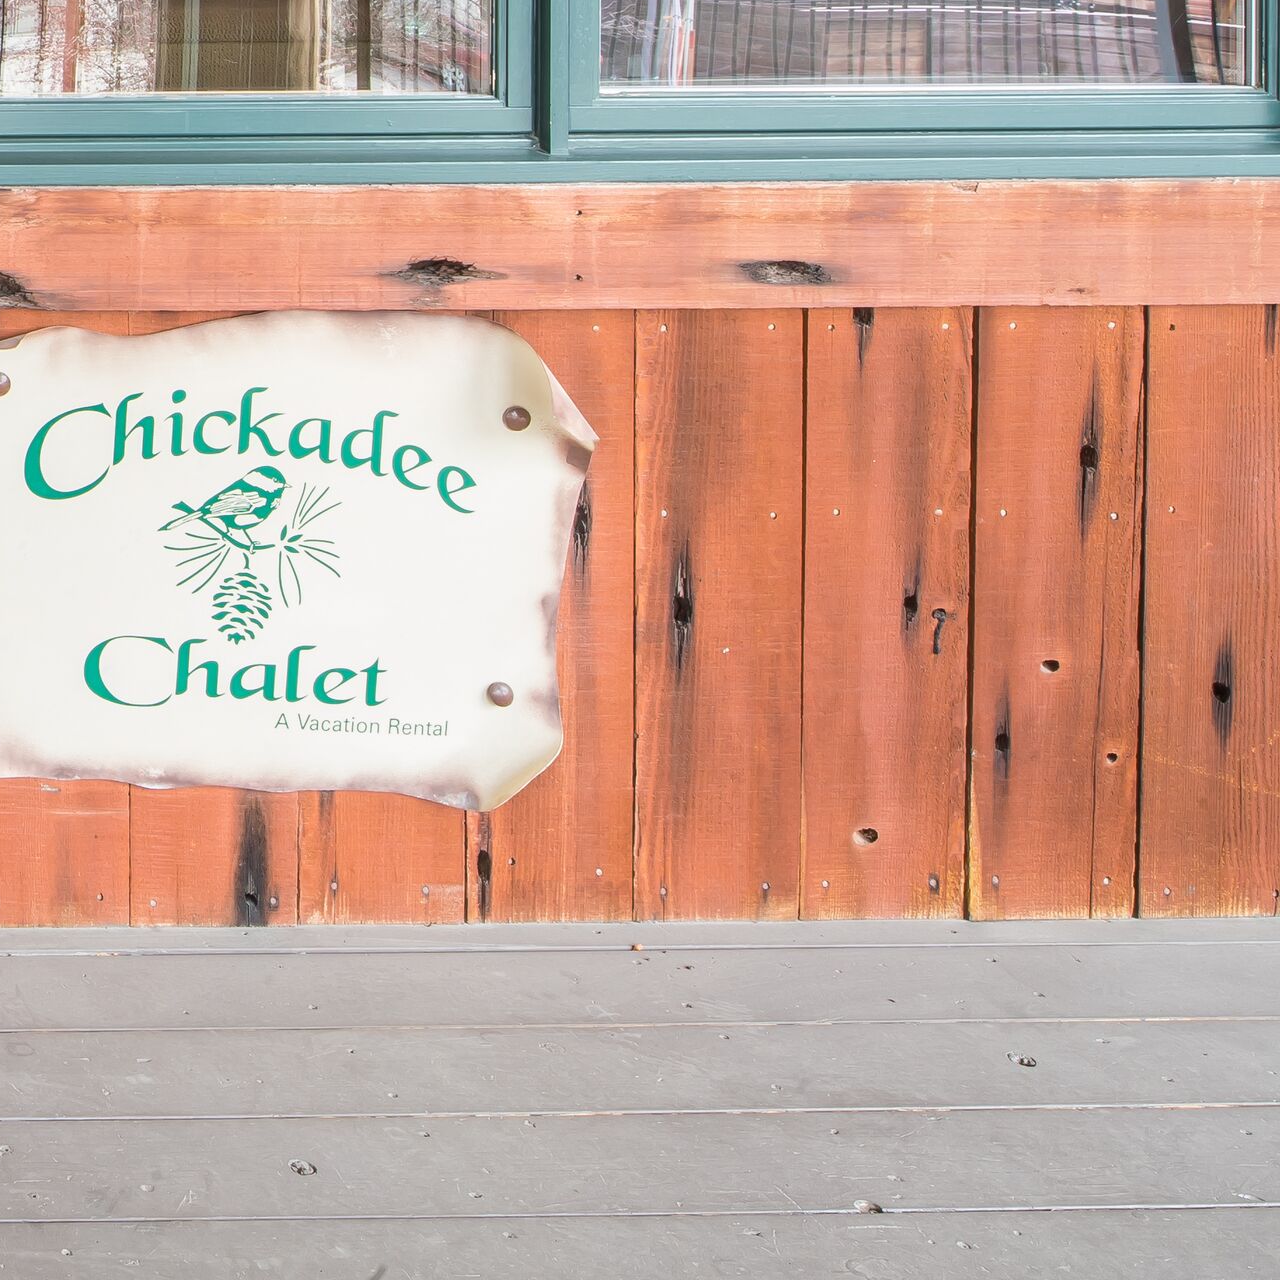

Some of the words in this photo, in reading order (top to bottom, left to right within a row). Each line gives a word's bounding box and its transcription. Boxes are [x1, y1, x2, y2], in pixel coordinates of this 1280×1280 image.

[23, 386, 477, 514] Chickadee
[83, 635, 388, 707] Chalet
[274, 712, 290, 729] A
[297, 713, 380, 734] Vacation
[388, 718, 449, 737] Rental
